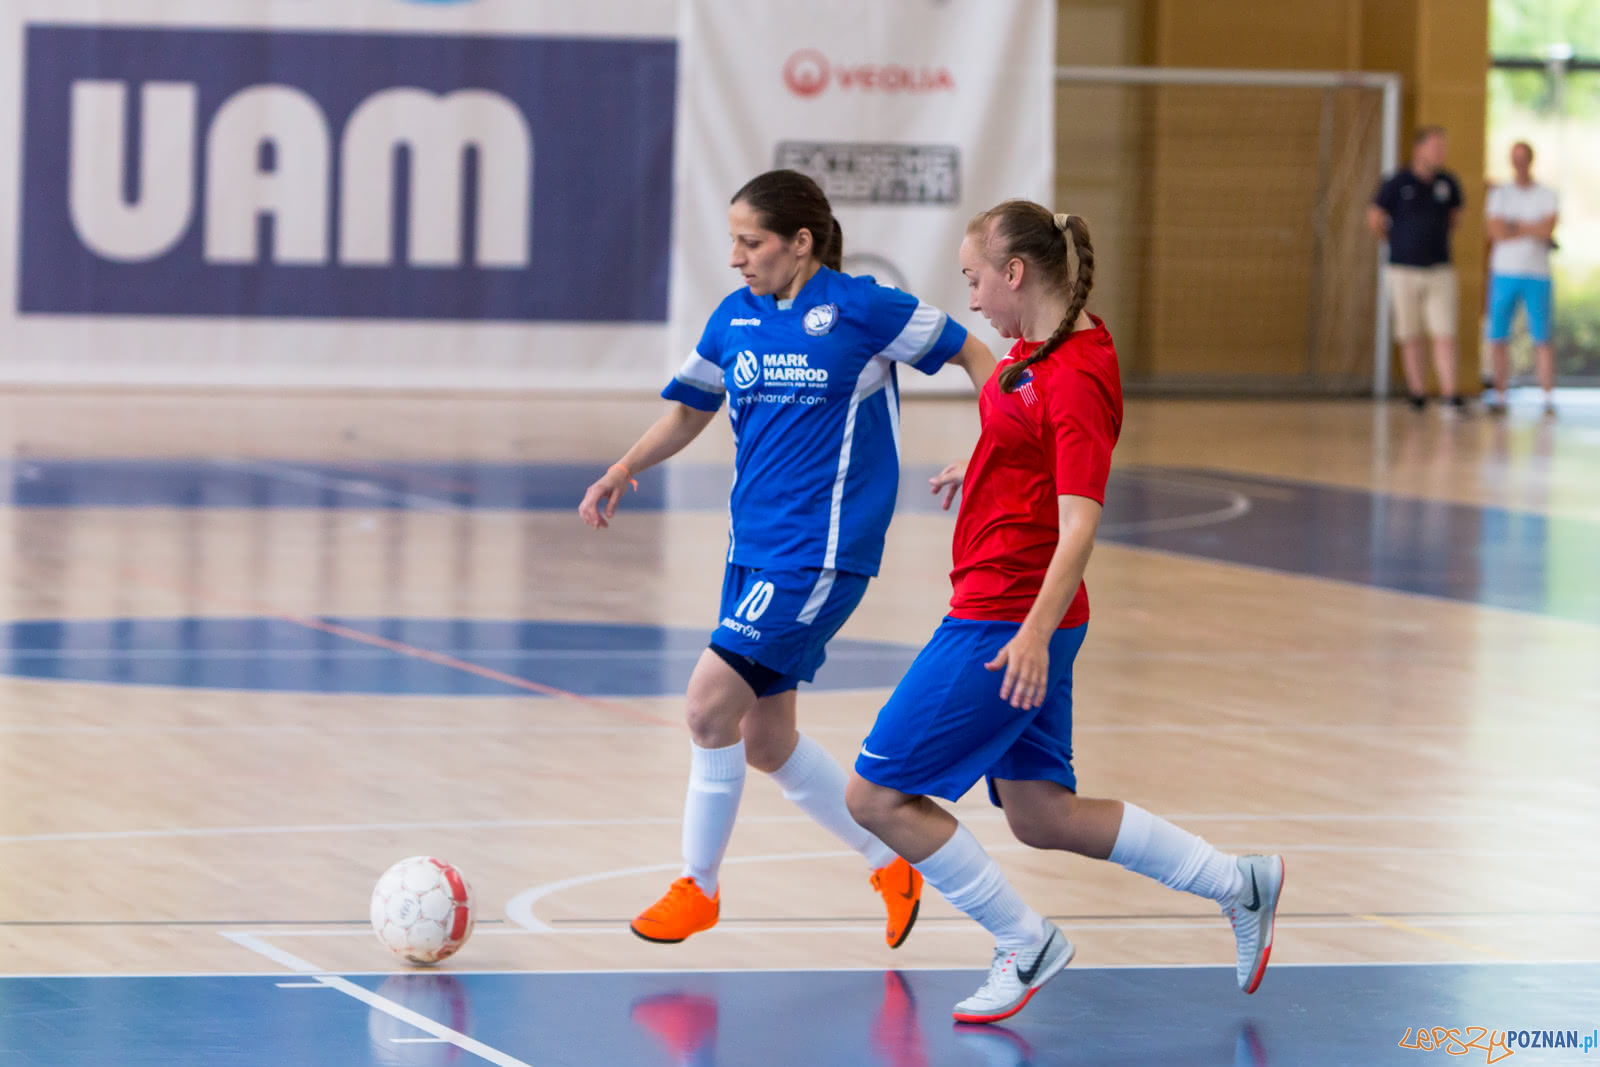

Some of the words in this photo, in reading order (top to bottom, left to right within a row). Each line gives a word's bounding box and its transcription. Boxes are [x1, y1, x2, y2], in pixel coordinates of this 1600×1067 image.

[833, 66, 955, 93] VEOLIA
[70, 80, 532, 268] UAM
[763, 354, 808, 367] MARK
[764, 368, 828, 382] HARROD
[736, 581, 774, 622] 10
